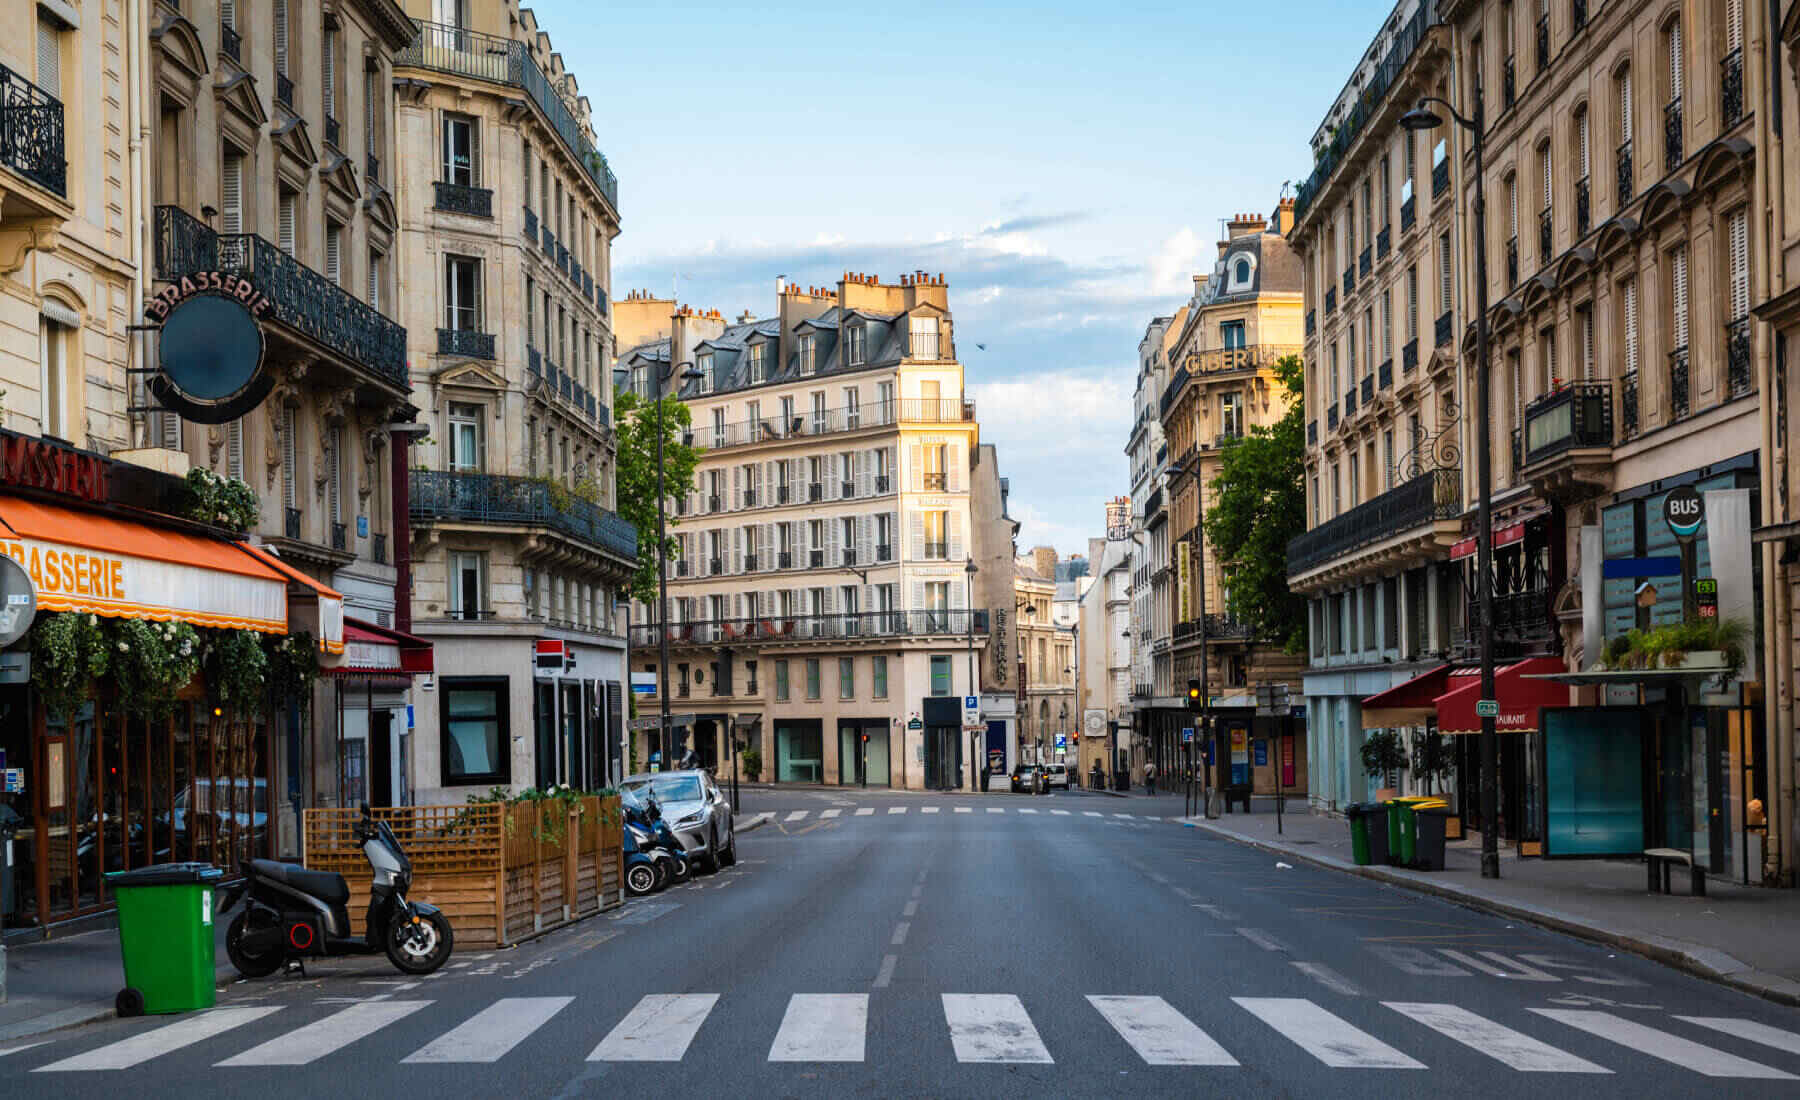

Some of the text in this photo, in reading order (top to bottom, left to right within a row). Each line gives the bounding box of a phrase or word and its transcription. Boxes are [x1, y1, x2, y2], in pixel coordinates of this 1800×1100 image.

[152, 271, 270, 317] BRASSERIE
[1185, 349, 1257, 373] GIBERT
[1670, 499, 1699, 515] BUS
